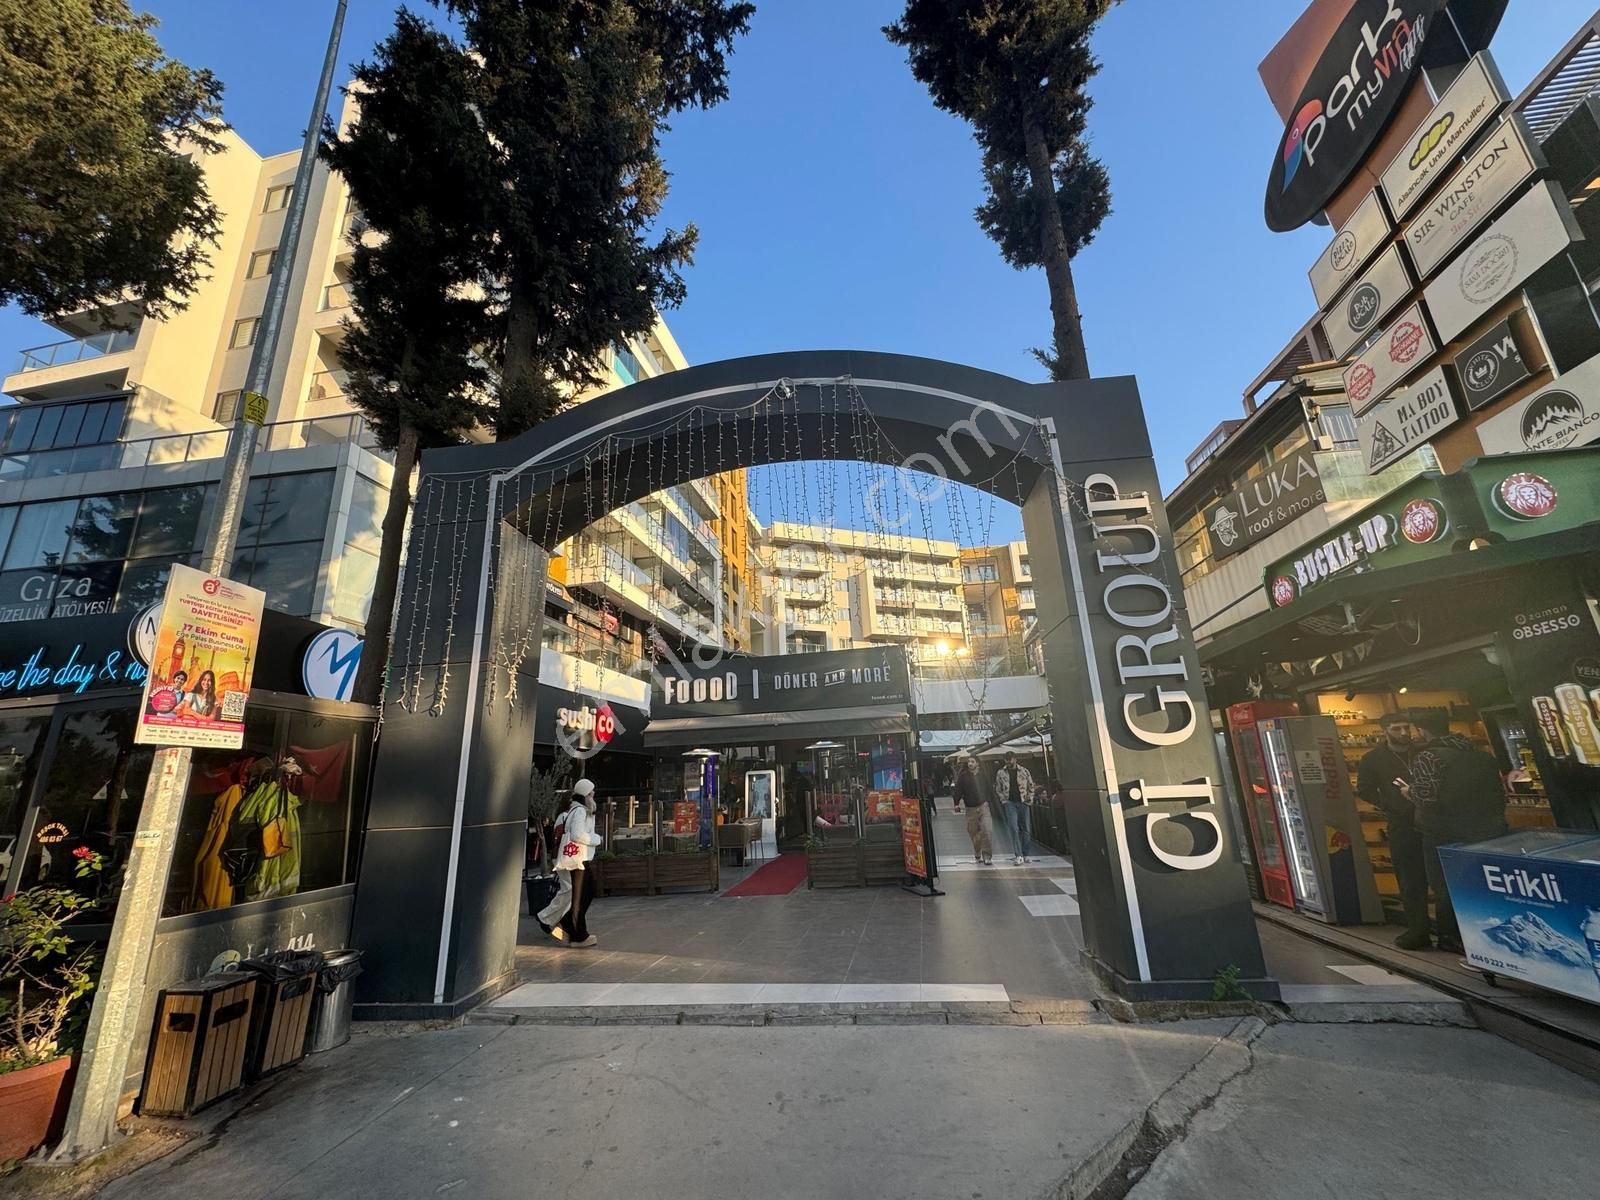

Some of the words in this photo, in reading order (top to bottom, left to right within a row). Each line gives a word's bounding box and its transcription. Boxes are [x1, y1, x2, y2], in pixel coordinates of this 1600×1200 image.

[1304, 0, 1402, 167] park
[1413, 219, 1435, 244] SIR
[1434, 137, 1509, 217] WINSTON
[1449, 192, 1476, 221] CAFE
[1555, 412, 1600, 440] BIANCO
[1239, 455, 1318, 517] LUKA
[1248, 512, 1275, 536] roof
[1277, 507, 1287, 521] &
[1288, 489, 1324, 515] more
[1294, 514, 1388, 588] BUCKLE-UP
[20, 575, 92, 601] Giza
[1084, 473, 1197, 747] GROUP
[1513, 614, 1581, 640] OBSESSO
[1528, 605, 1568, 620] zaman
[183, 623, 193, 632] 17
[195, 626, 218, 638] Ekim
[220, 632, 244, 644] Cuma
[190, 633, 207, 643] Palas
[208, 636, 234, 648] Business
[235, 641, 247, 651] Otel
[17, 647, 50, 690] the
[53, 644, 96, 695] day
[100, 650, 121, 680] &
[664, 672, 737, 705] FOOOD
[774, 671, 818, 690] DÖNER
[824, 671, 846, 684] AND
[851, 667, 891, 684] MORE
[1540, 703, 1557, 737] OBSESSO
[1567, 691, 1588, 736] OBSESSO
[1482, 864, 1562, 902] Erikli
